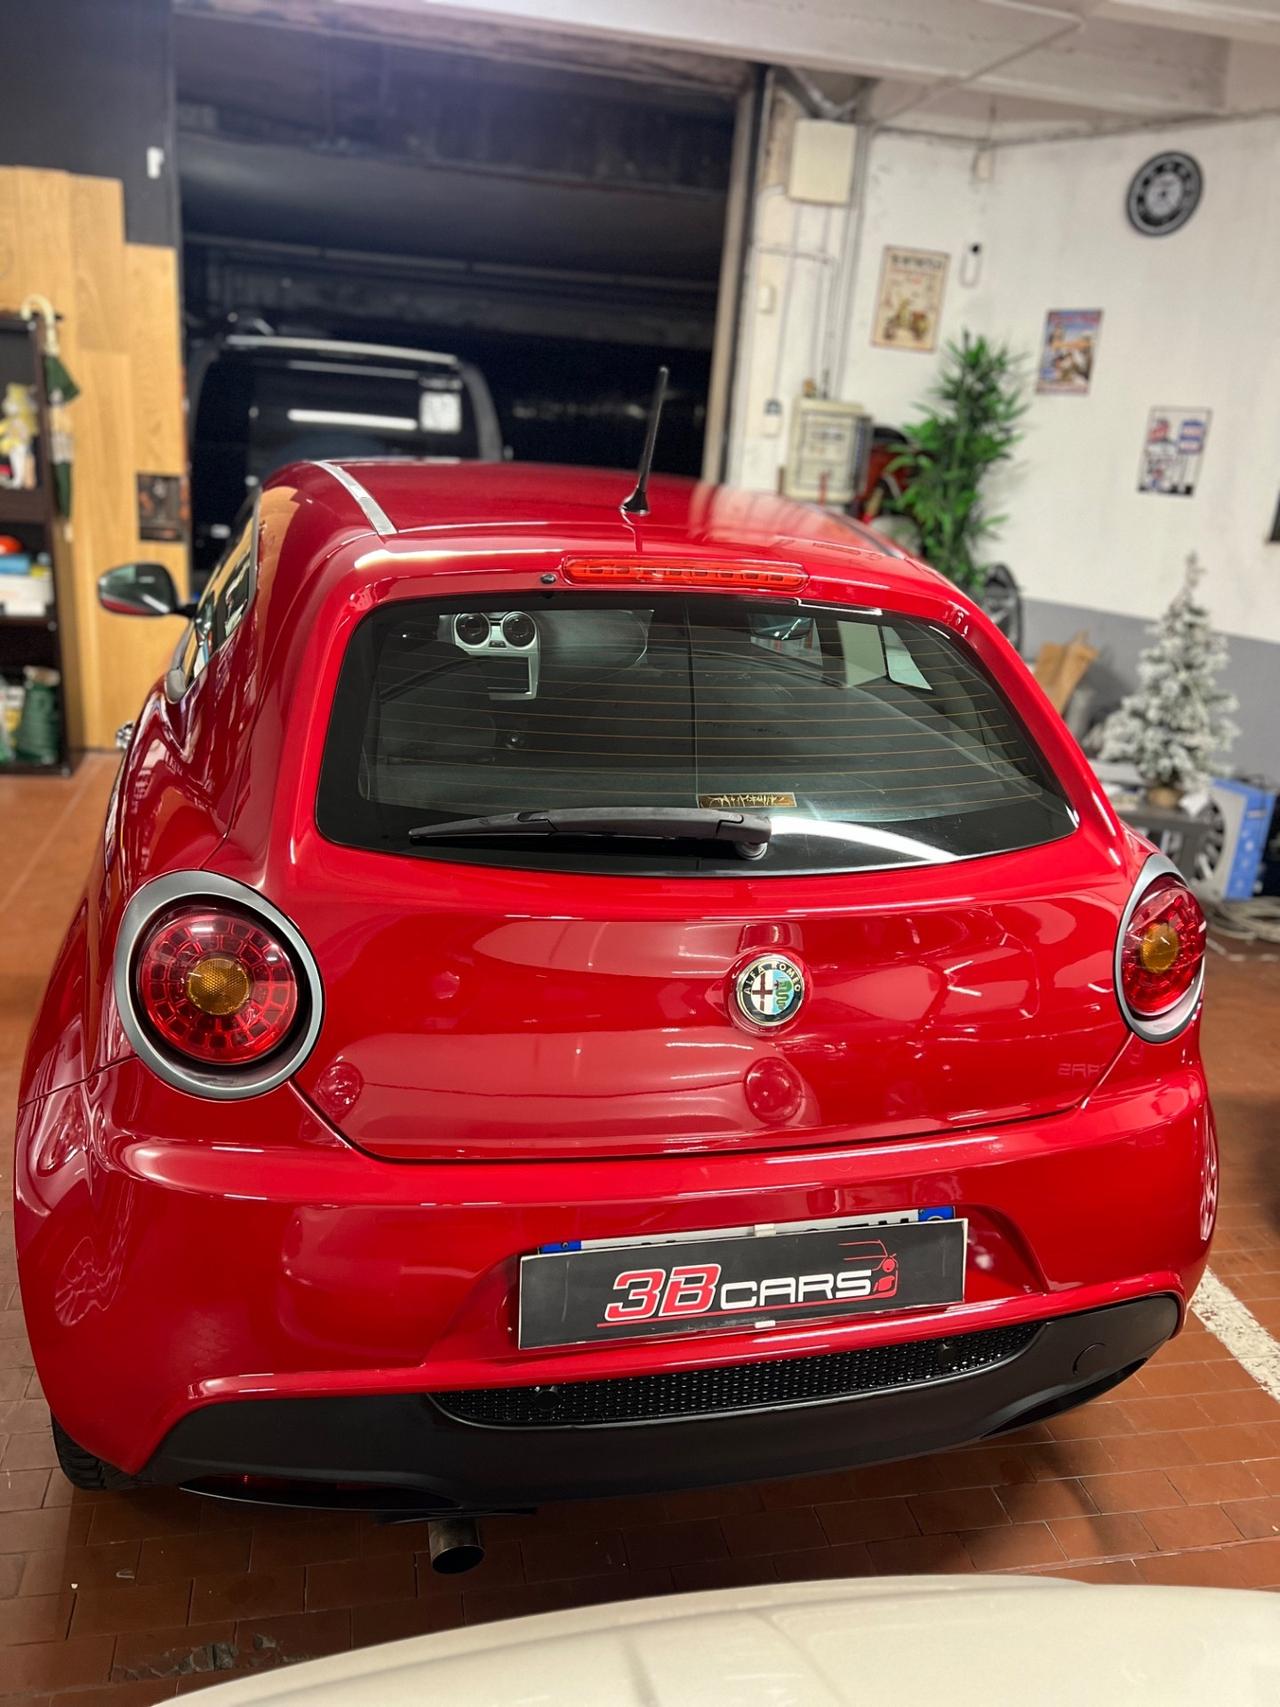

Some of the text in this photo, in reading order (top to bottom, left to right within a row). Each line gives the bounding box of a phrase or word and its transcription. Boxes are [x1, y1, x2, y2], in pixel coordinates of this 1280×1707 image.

[743, 961, 801, 995] ALFA ROMEO
[604, 1263, 872, 1322] 3B CARS
